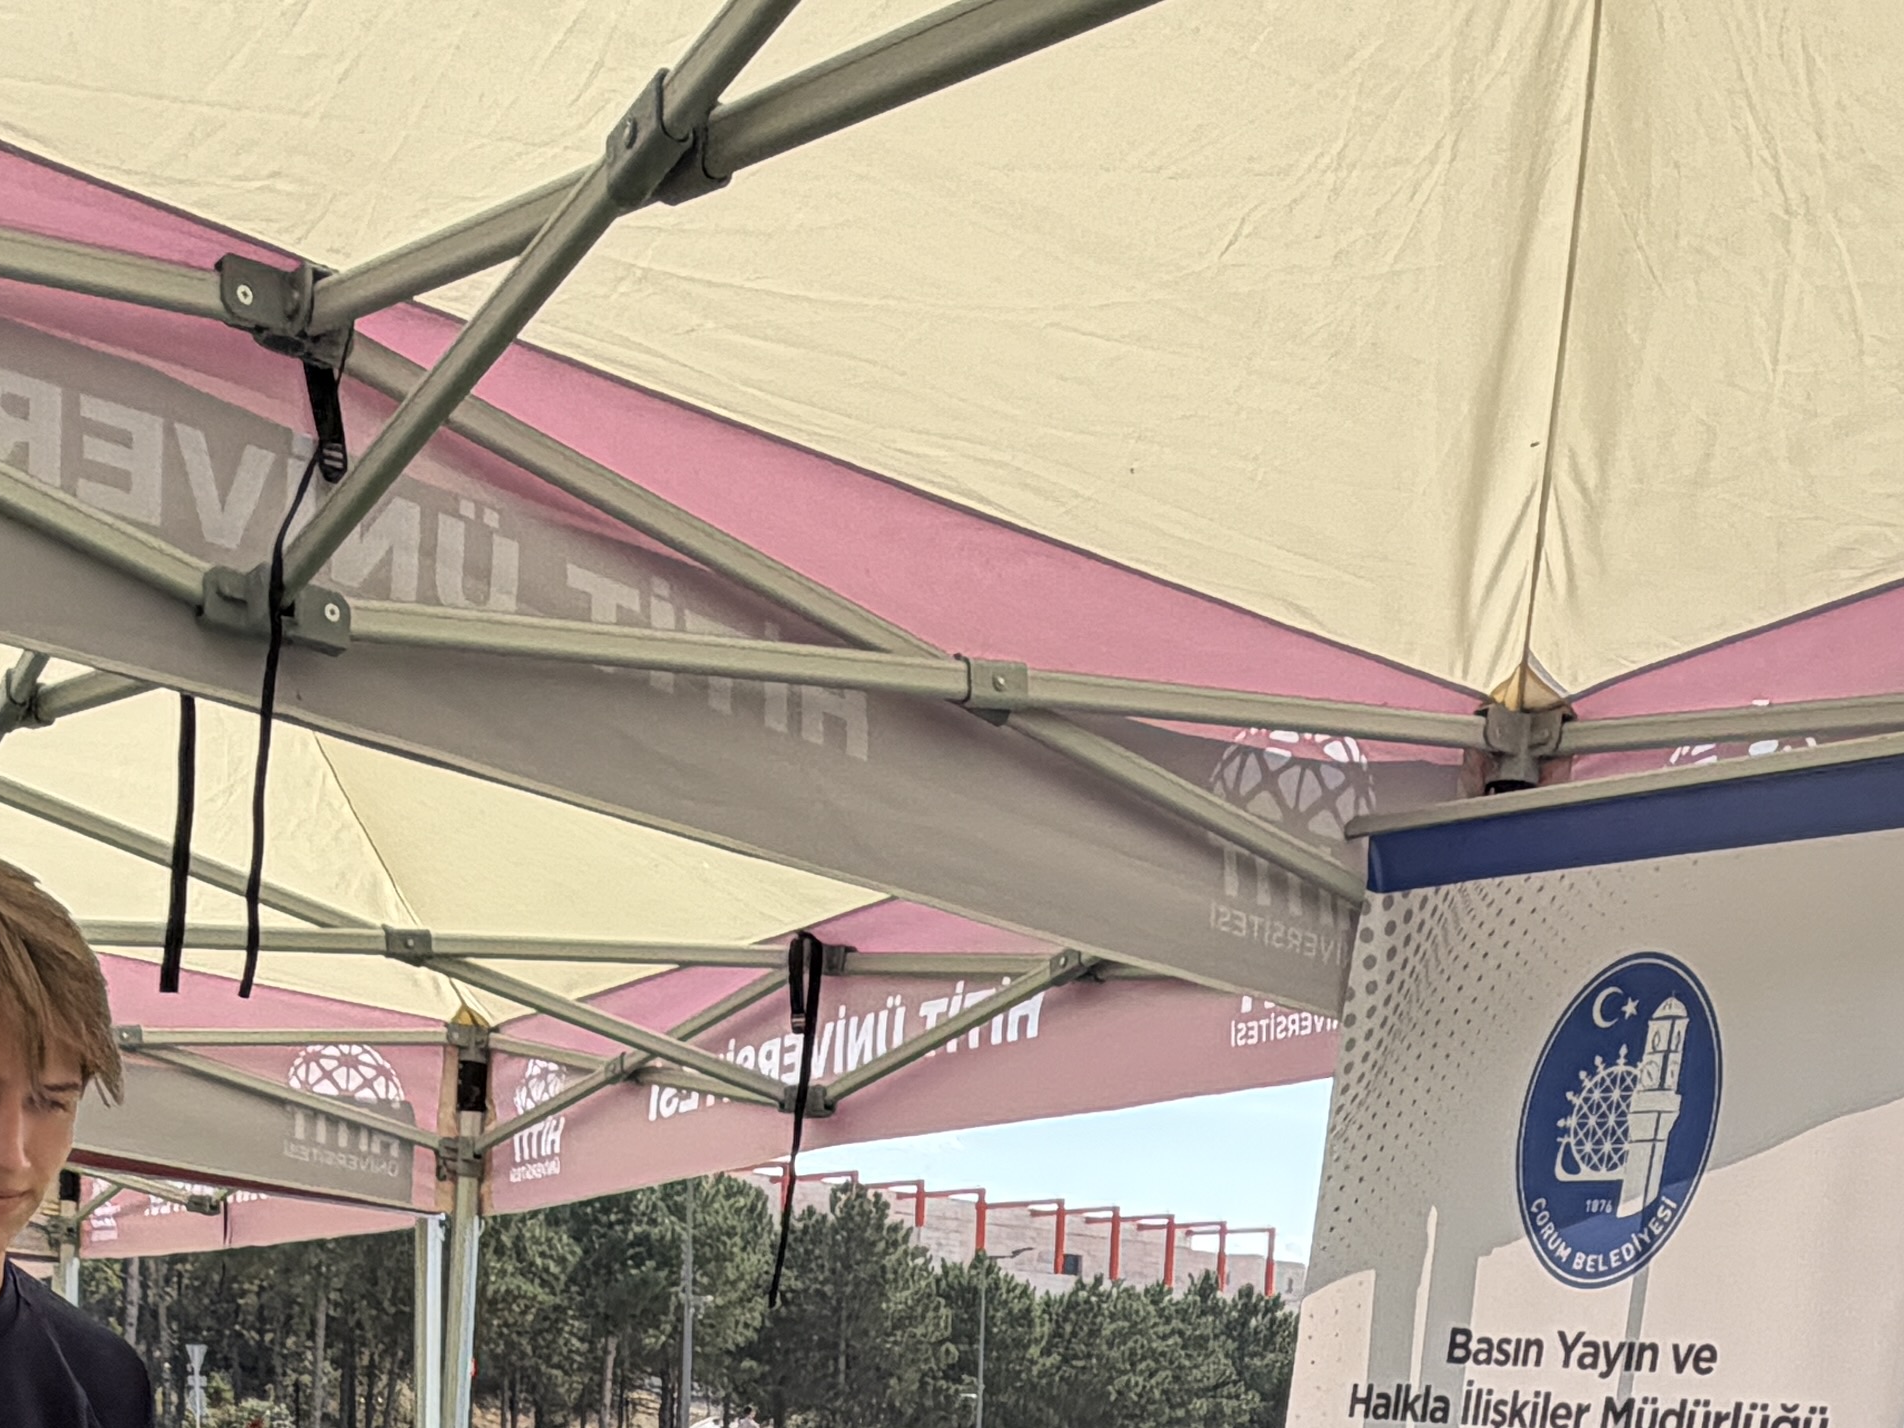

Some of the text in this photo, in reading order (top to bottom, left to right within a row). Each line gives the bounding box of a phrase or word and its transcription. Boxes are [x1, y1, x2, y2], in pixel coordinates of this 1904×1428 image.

[1571, 1195, 1679, 1273] BELEDİYESİ
[1447, 1327, 1719, 1382] Basın Yayın ve
[1348, 1385, 1450, 1426] Halkla
